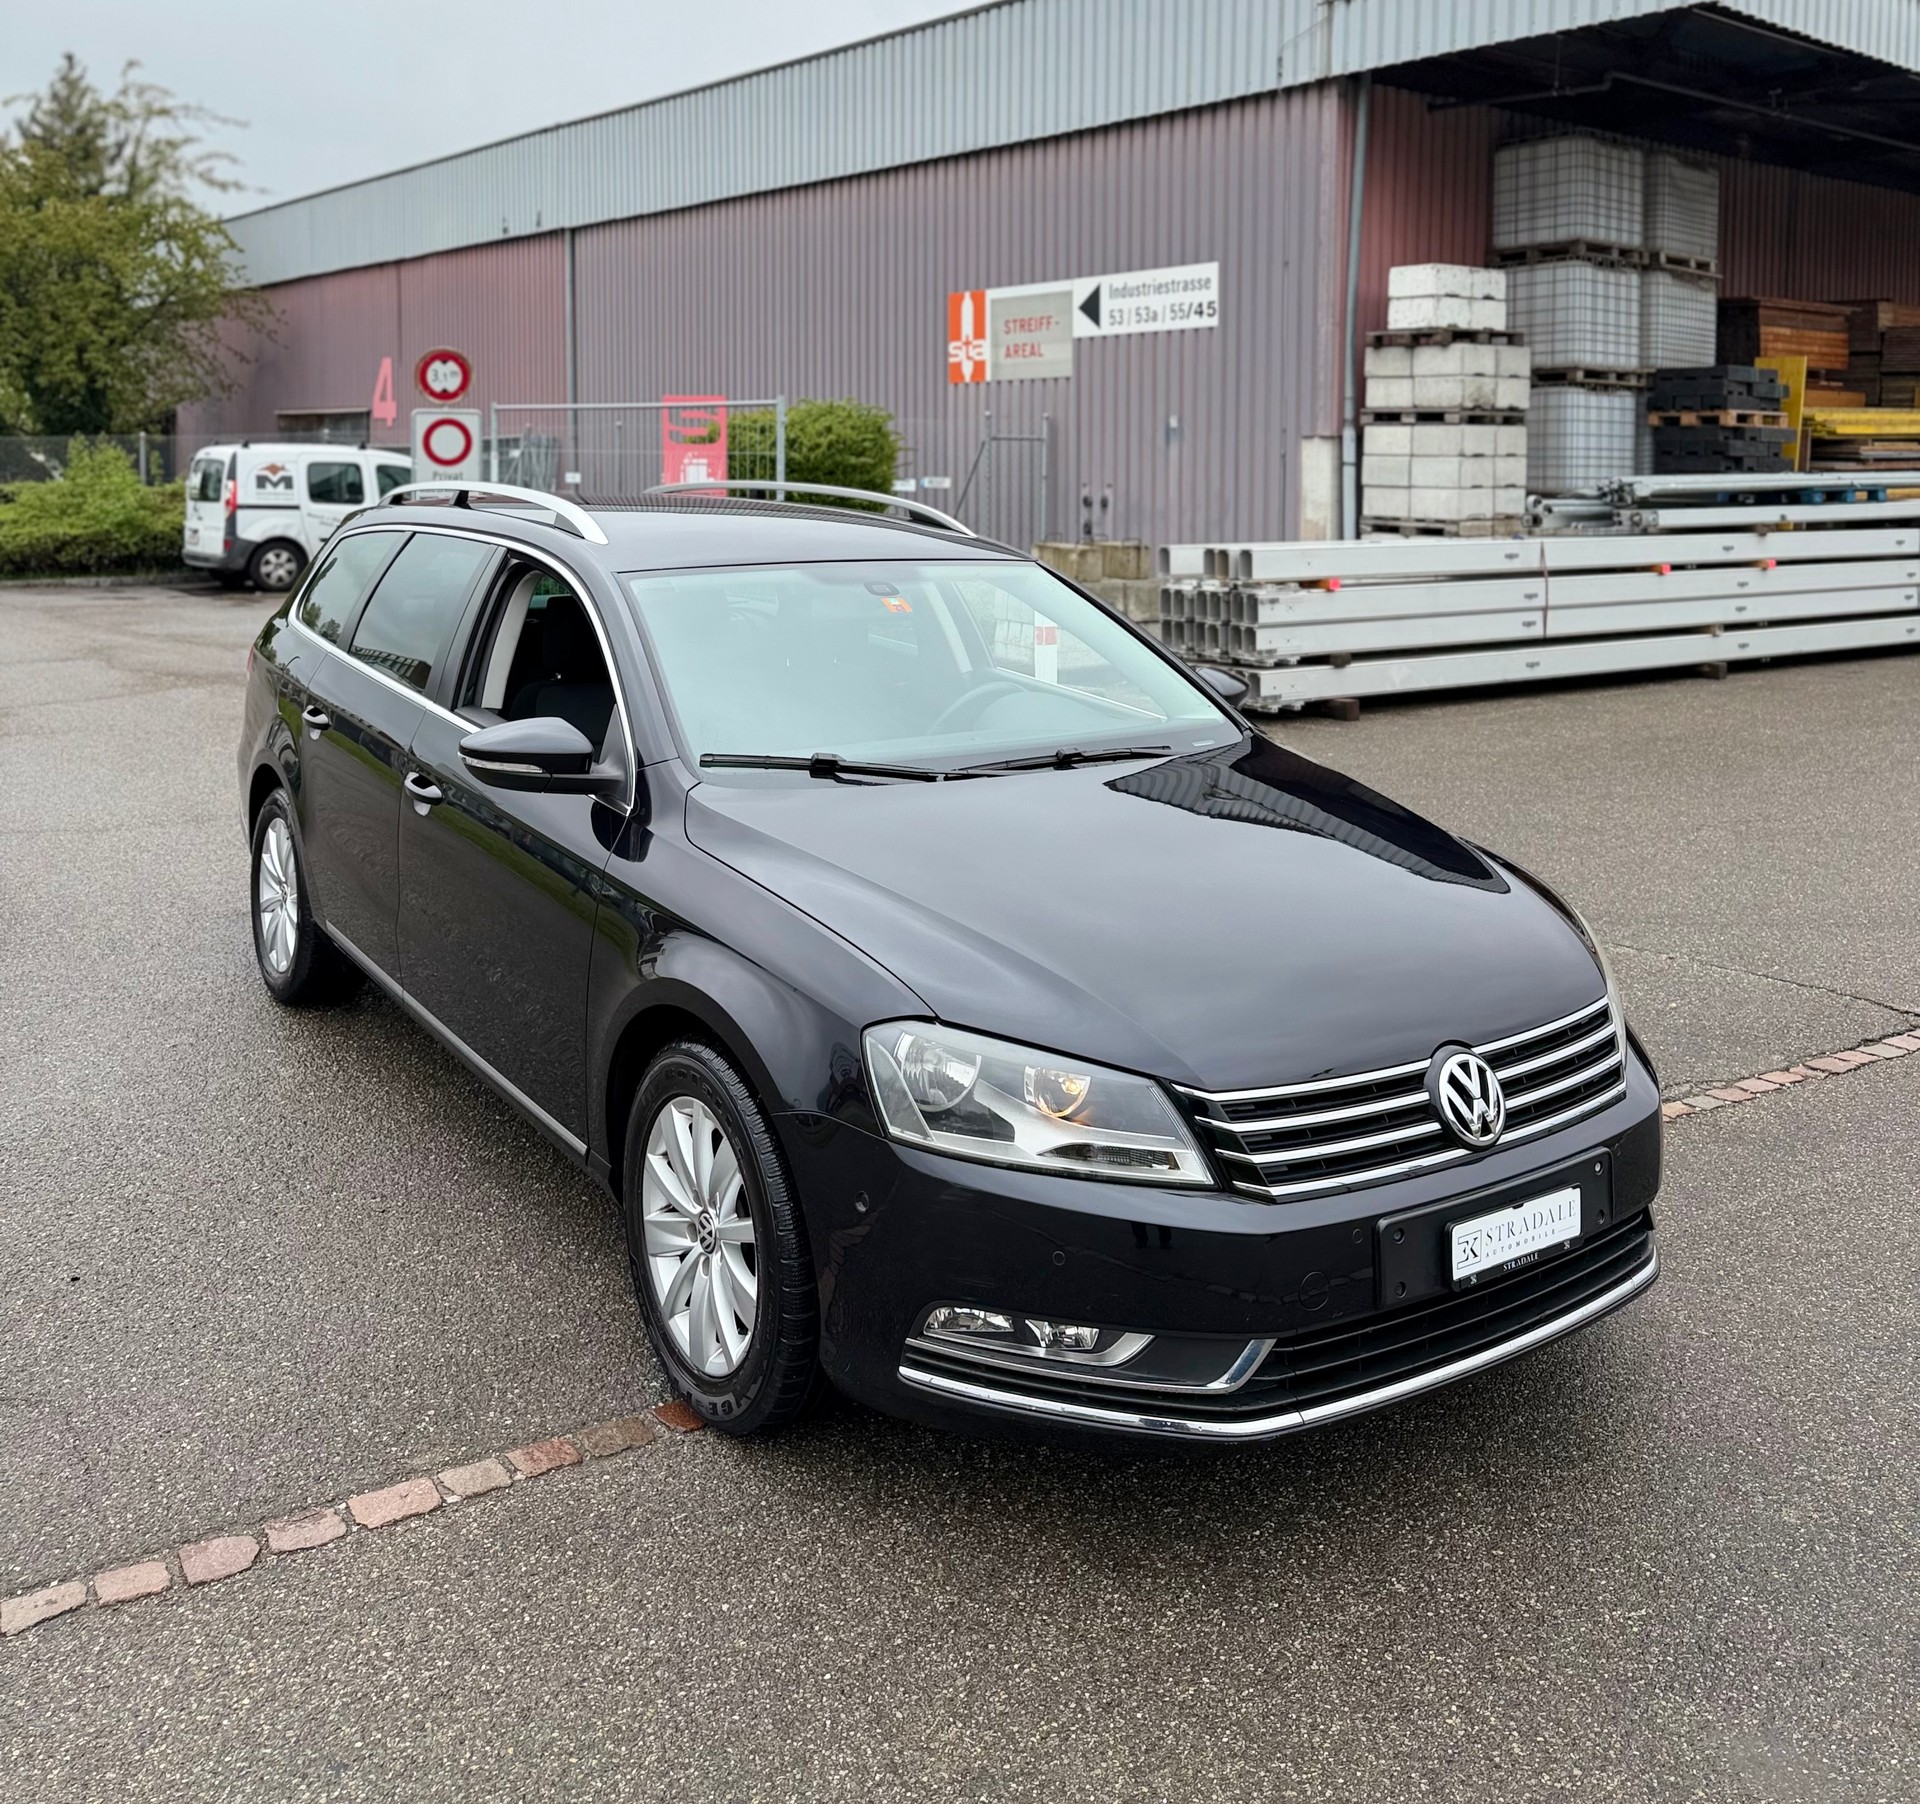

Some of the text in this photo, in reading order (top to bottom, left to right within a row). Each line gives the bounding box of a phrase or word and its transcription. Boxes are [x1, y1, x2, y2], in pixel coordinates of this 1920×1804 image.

[1108, 277, 1212, 300] Industriestrasse
[1004, 315, 1060, 335] STREIFF-
[1004, 342, 1045, 359] AREAL
[372, 357, 397, 428] 4
[432, 470, 464, 481] Privat
[1485, 1200, 1576, 1246] STRADALE
[1485, 1228, 1556, 1258] AUTOMOBILE
[1503, 1252, 1539, 1271] STRADALE
